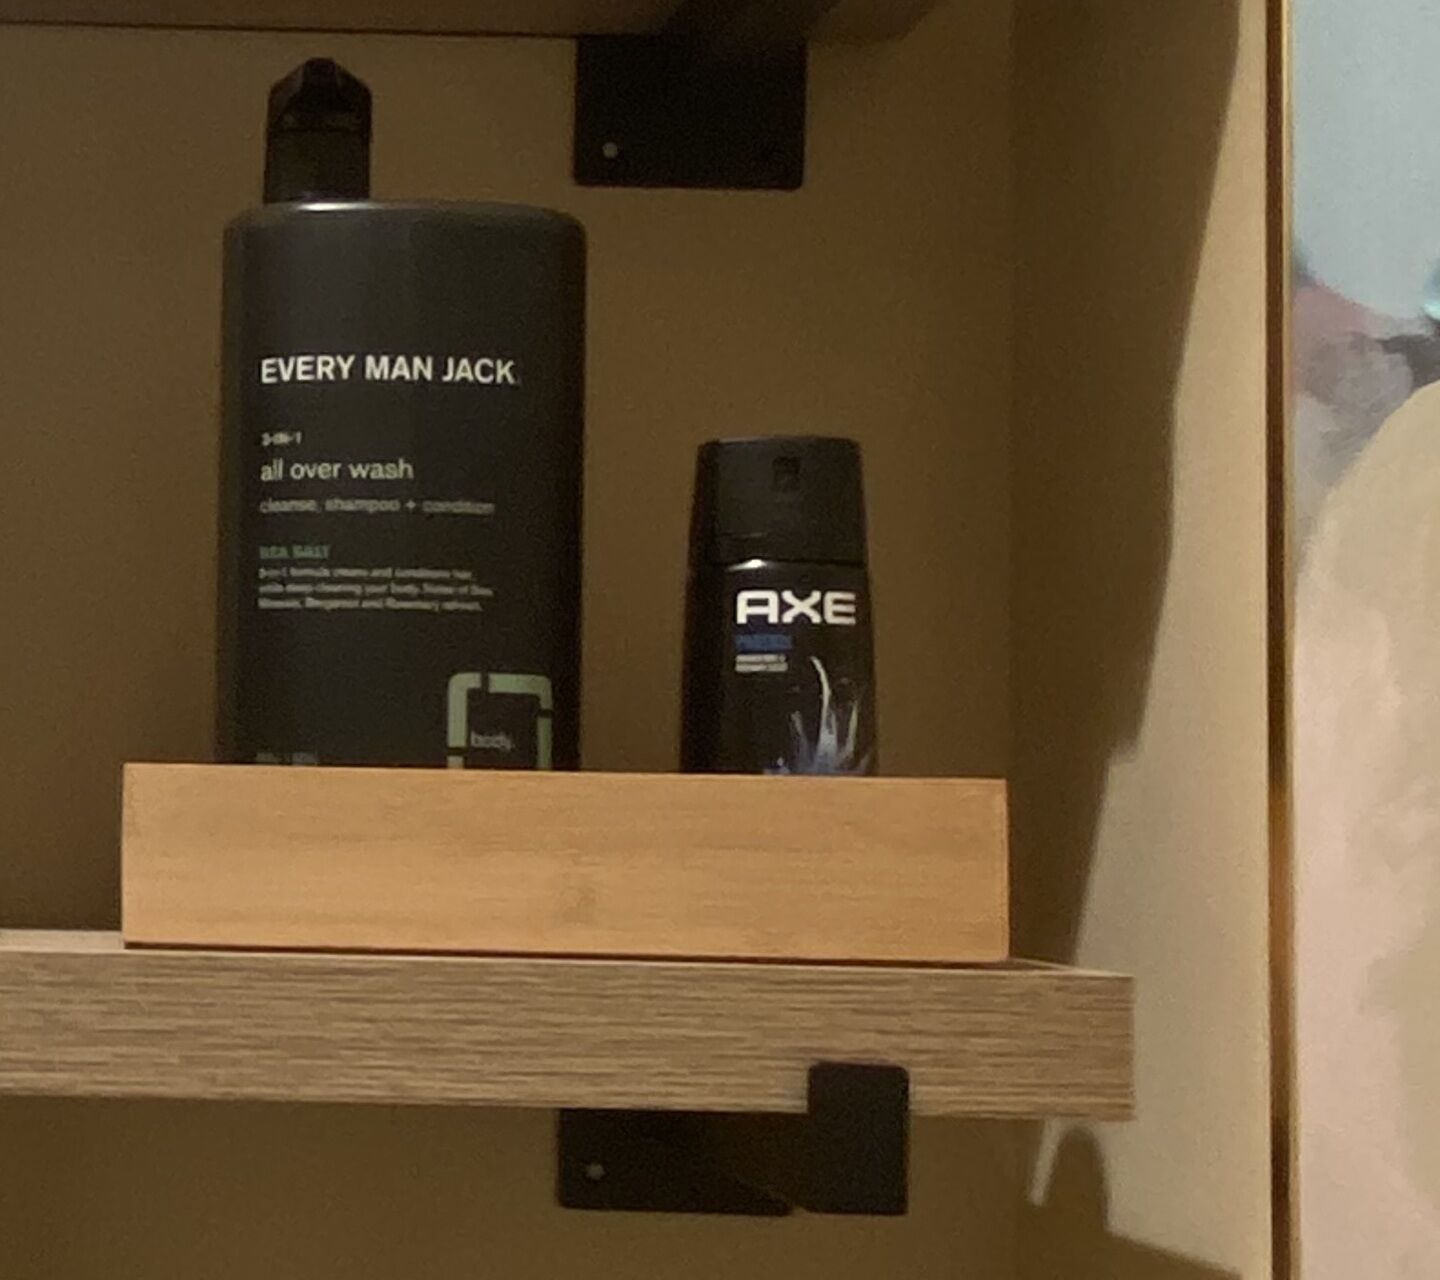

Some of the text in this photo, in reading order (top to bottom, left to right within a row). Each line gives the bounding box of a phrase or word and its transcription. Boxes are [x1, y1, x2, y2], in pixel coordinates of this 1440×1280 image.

[261, 354, 517, 385] EVERY MAN JACK
[260, 458, 414, 482] all over wash
[735, 589, 857, 626] AXE
